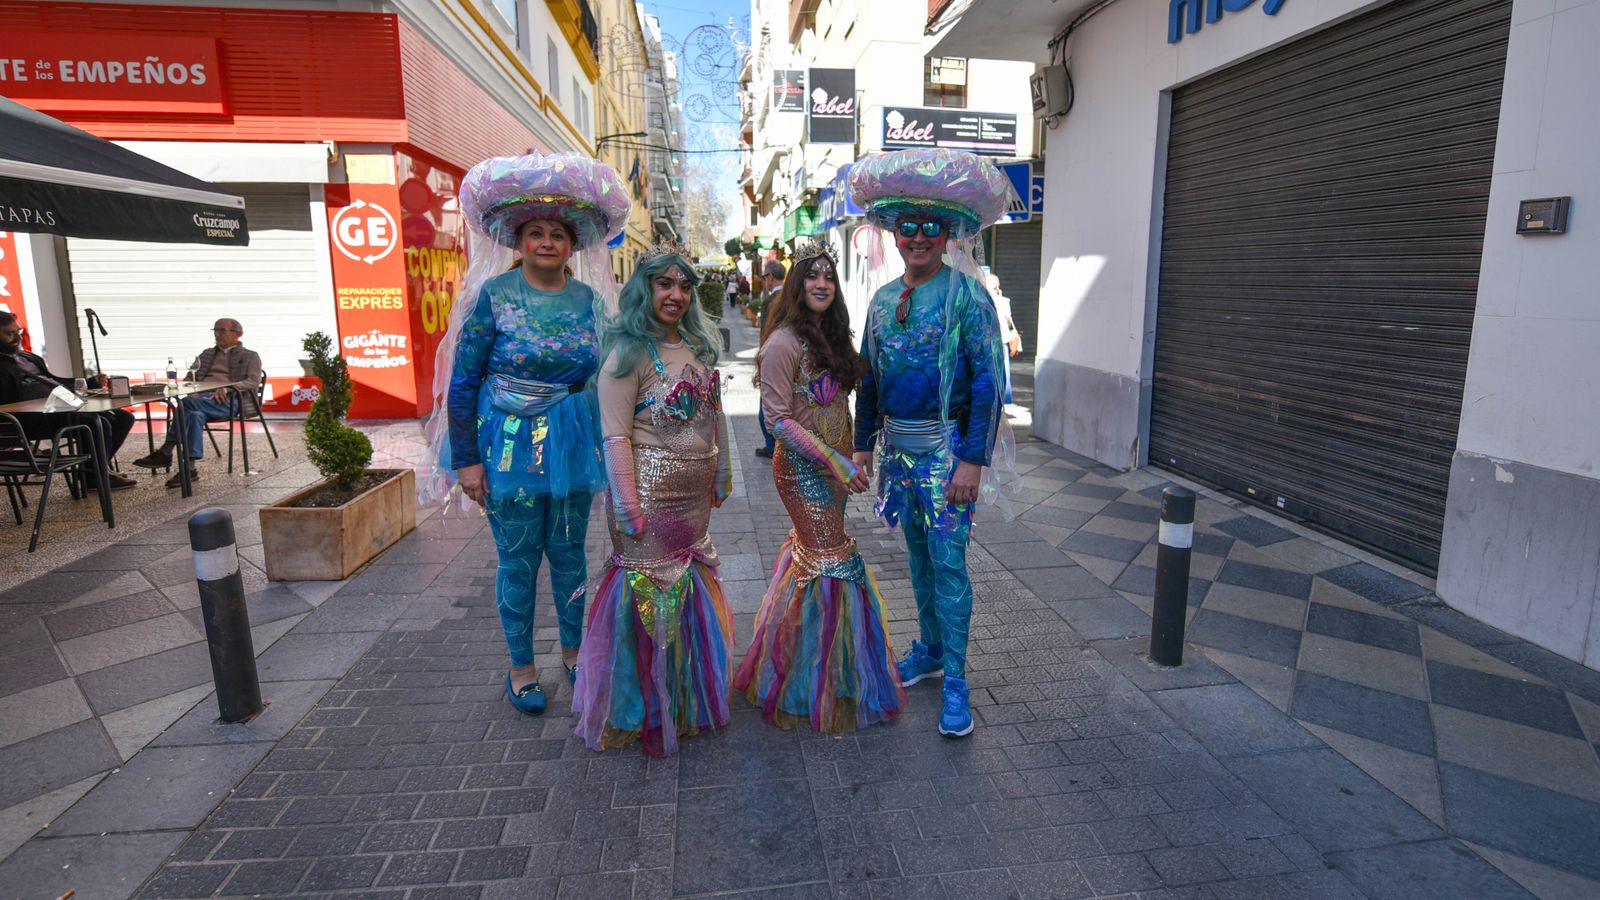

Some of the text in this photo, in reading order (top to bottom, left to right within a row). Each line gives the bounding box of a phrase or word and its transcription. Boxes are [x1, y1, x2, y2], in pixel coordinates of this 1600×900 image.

[35, 59, 50, 69] de
[58, 56, 207, 85] EMPEÑOS
[35, 70, 54, 80] los
[193, 213, 240, 231] Cruzcampo
[206, 228, 235, 238] ESPECIAL
[338, 216, 390, 247] GE
[338, 287, 402, 296] REPARACIONES
[339, 292, 404, 310] EXPRÉS
[421, 290, 454, 334] OR
[343, 334, 407, 349] GIGANTE
